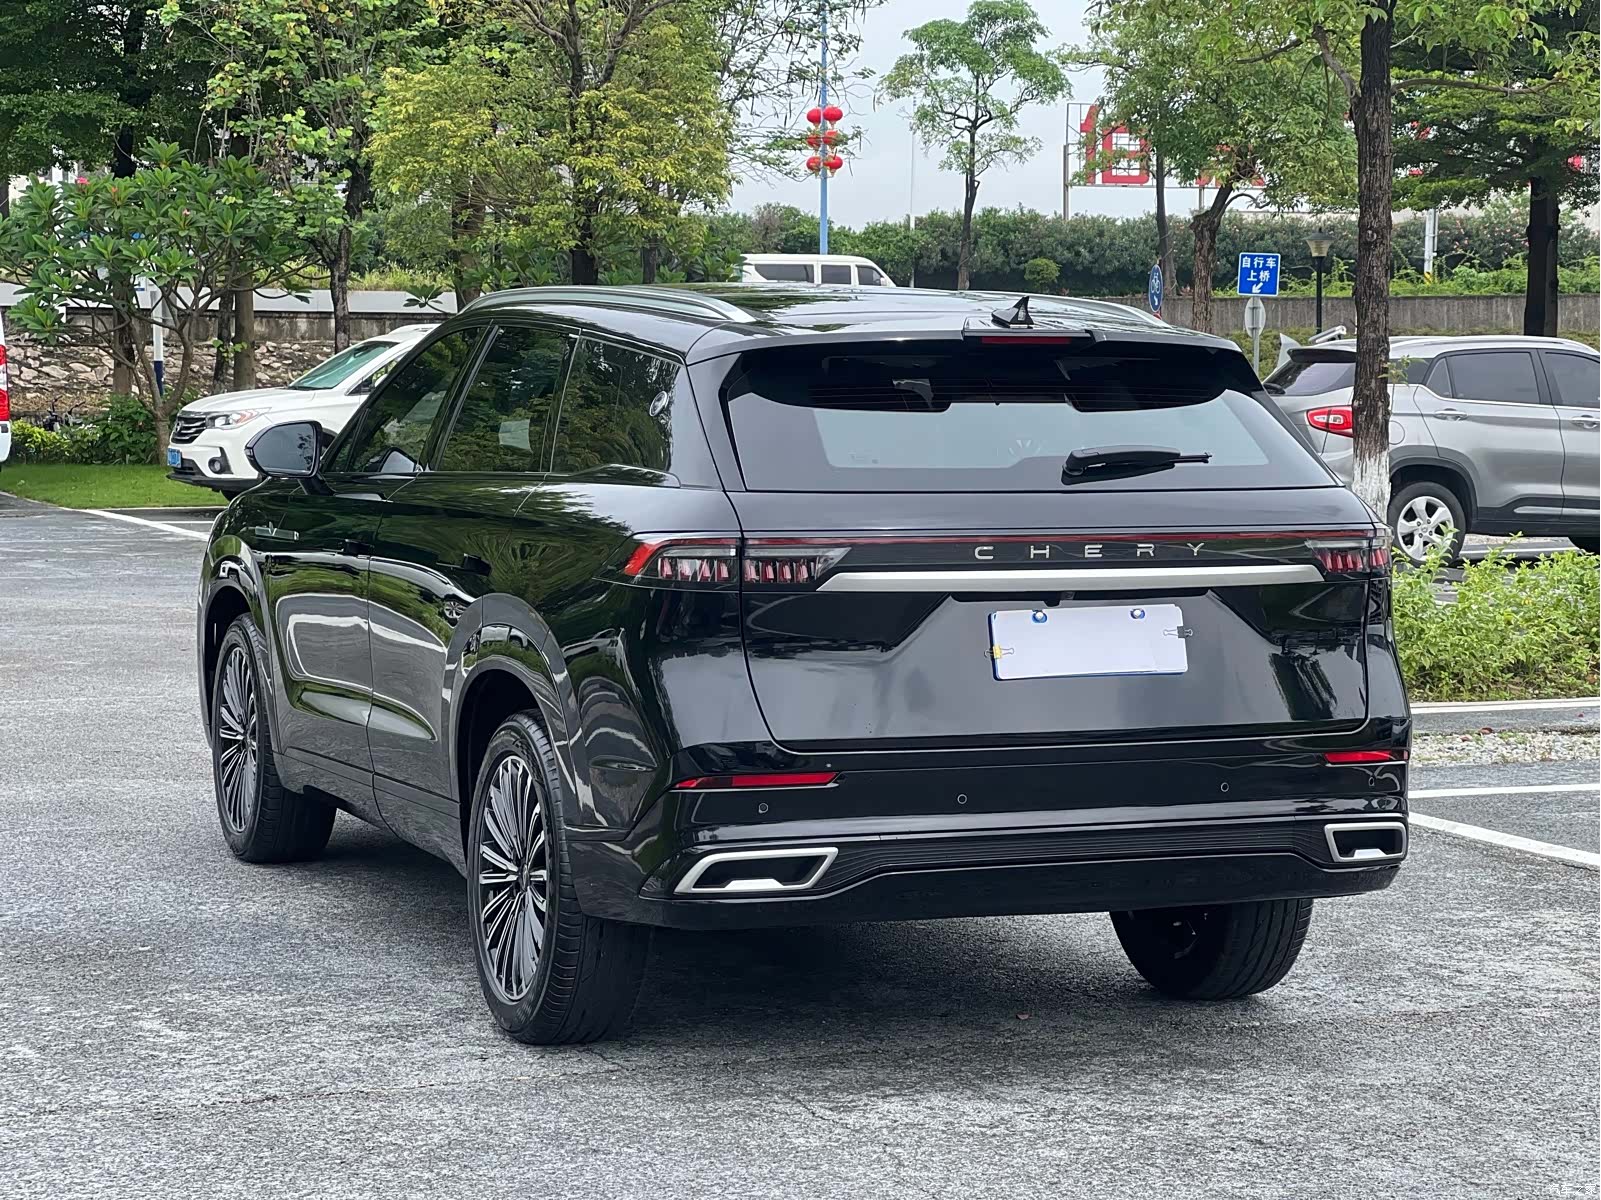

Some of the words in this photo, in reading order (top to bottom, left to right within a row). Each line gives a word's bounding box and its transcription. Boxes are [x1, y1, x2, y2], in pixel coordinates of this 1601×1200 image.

[1242, 256, 1277, 269] 自行车
[1246, 269, 1270, 282] 上桥
[974, 542, 1205, 560] CHERY
